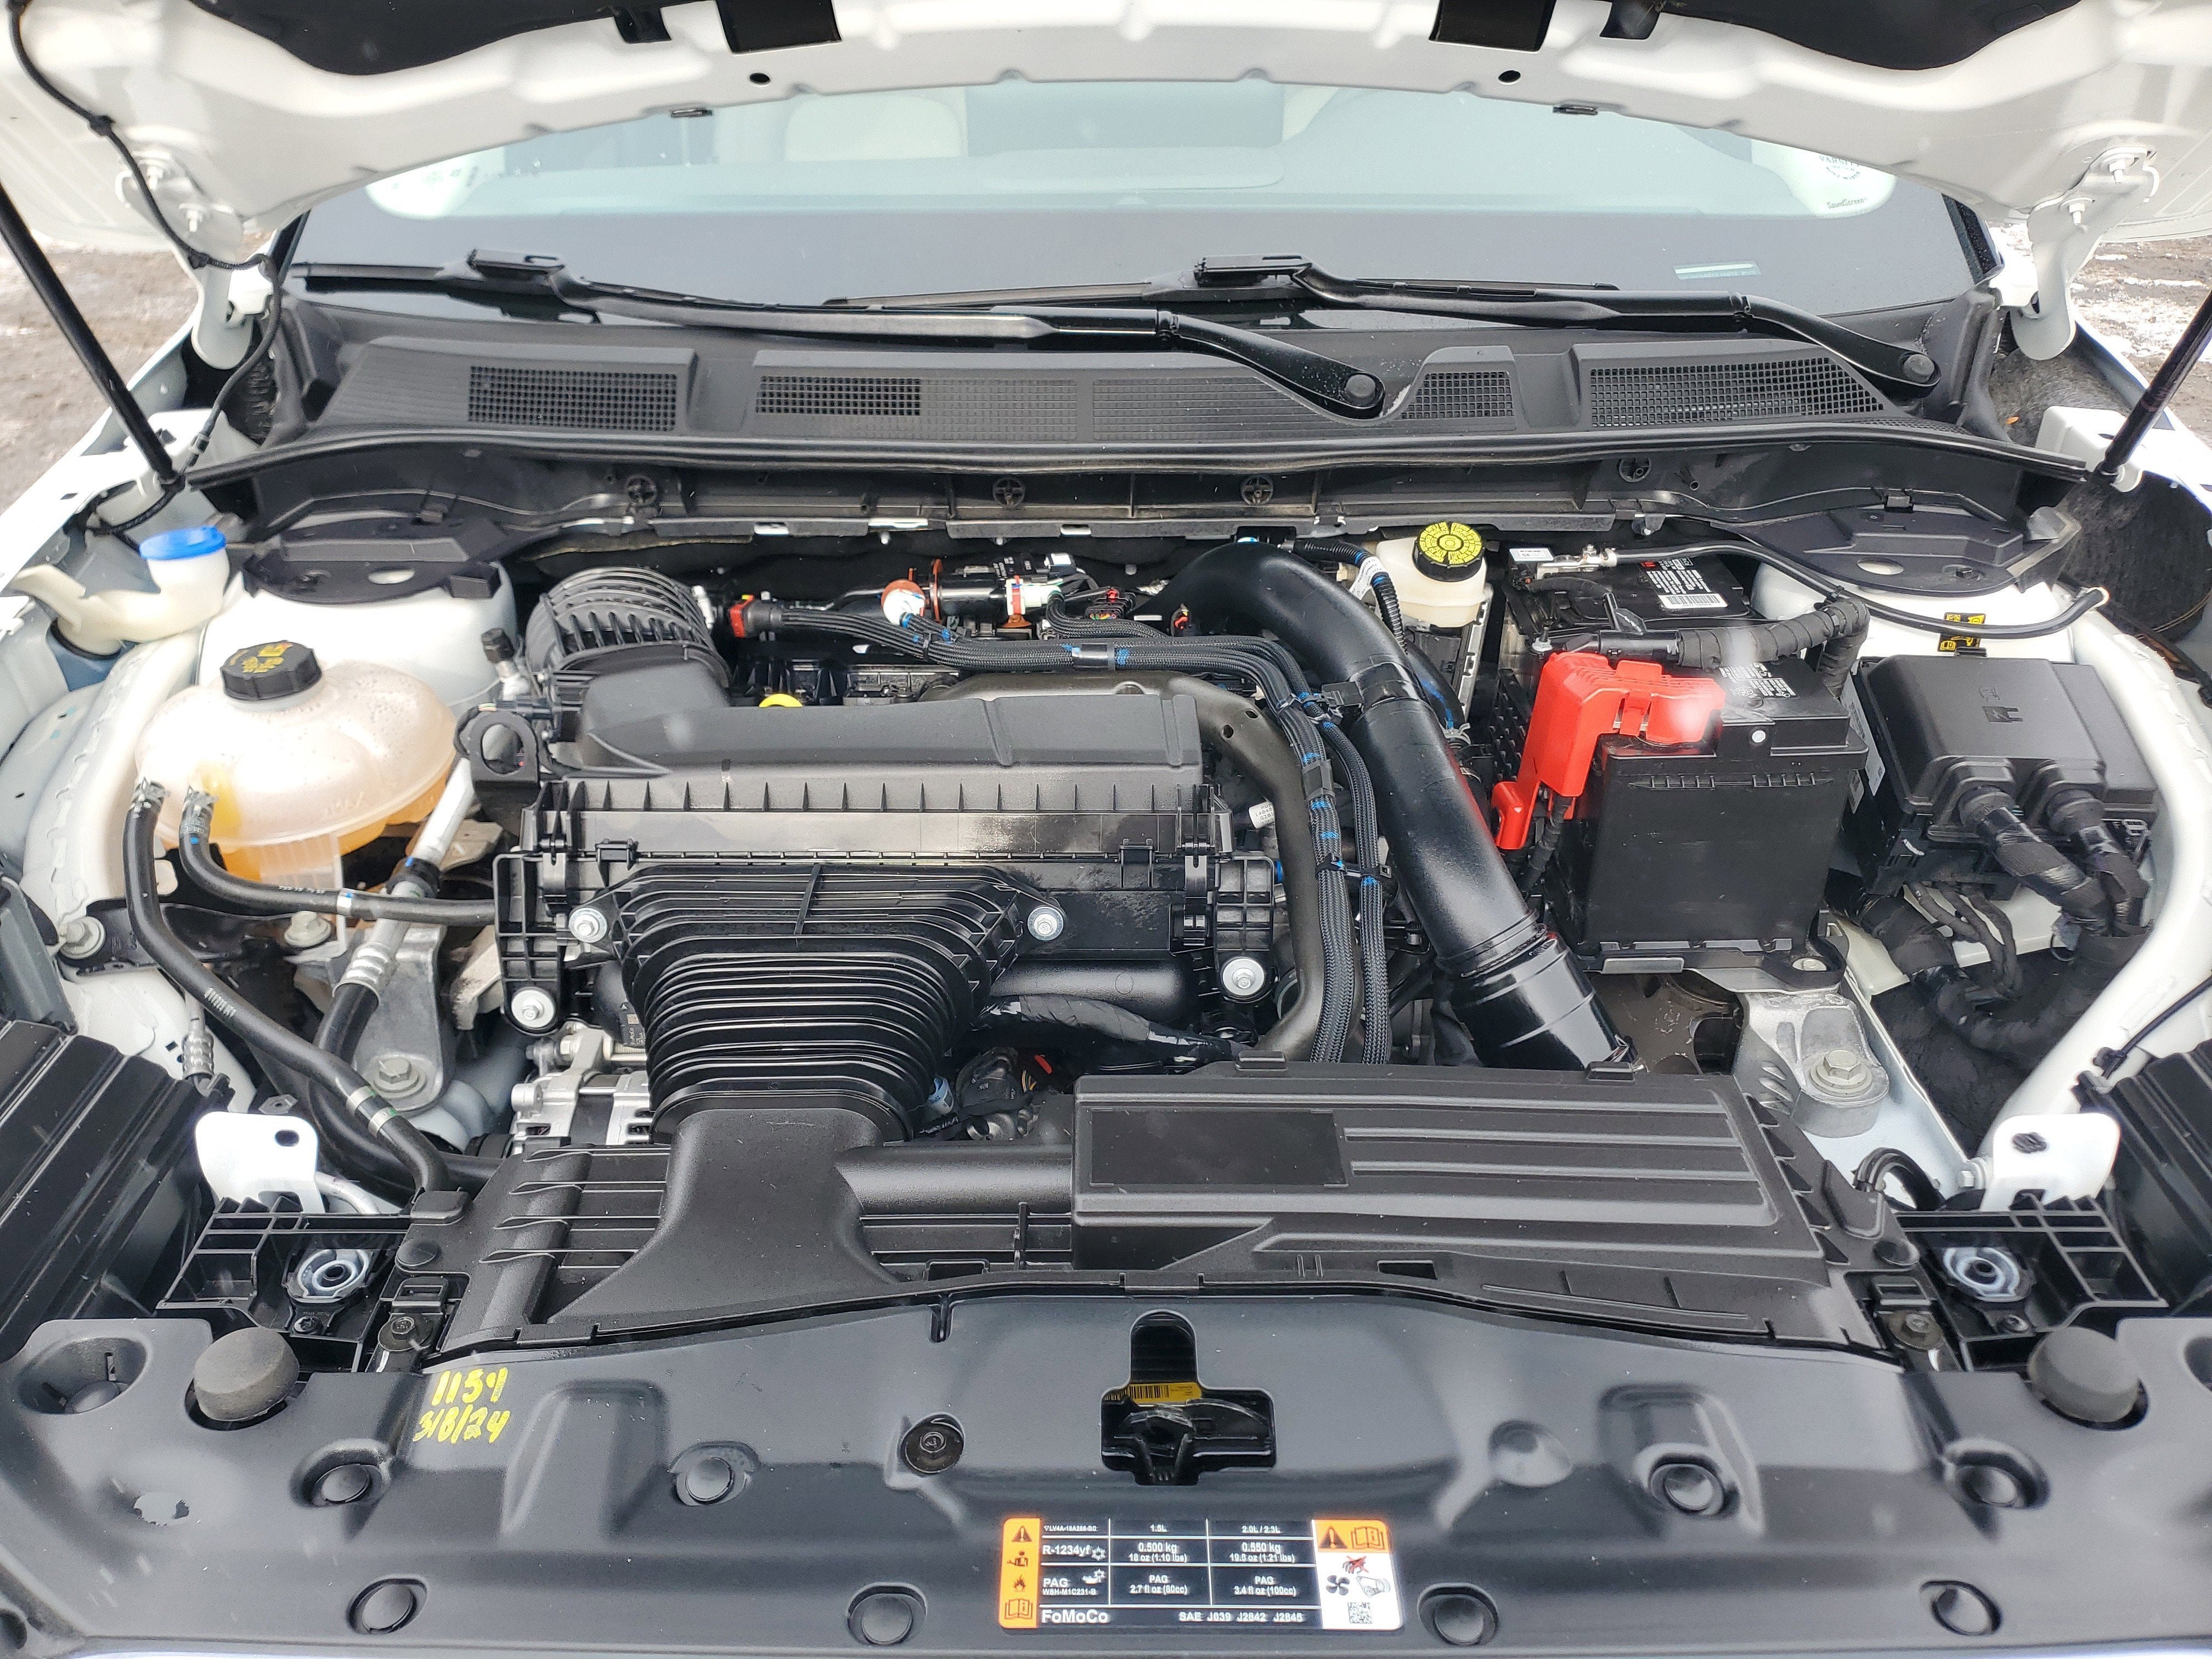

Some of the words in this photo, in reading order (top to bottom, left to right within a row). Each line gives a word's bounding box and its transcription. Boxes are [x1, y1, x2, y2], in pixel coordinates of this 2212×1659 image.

[1819, 156, 1859, 167] VARSI
[1242, 1525, 1259, 1533] 2.0L
[1042, 1544, 1091, 1557] R-1234yf
[1138, 1542, 1163, 1553] 0.500
[1166, 1542, 1177, 1554] kg
[1242, 1542, 1267, 1552] 0.550
[1269, 1542, 1281, 1554] kg
[1172, 1553, 1187, 1563] lbs)
[1259, 1553, 1278, 1563] (1.21
[1280, 1553, 1295, 1563] lbs)
[1043, 1578, 1069, 1588] PAG
[1149, 1575, 1168, 1583] PAG
[1255, 1576, 1274, 1584] PAG
[1130, 1584, 1142, 1594] 2.7
[1234, 1585, 1246, 1595] 3.4
[1267, 1586, 1296, 1596] (100cc)
[1042, 1609, 1109, 1623] FoMoCo
[1179, 1611, 1202, 1621] SAE
